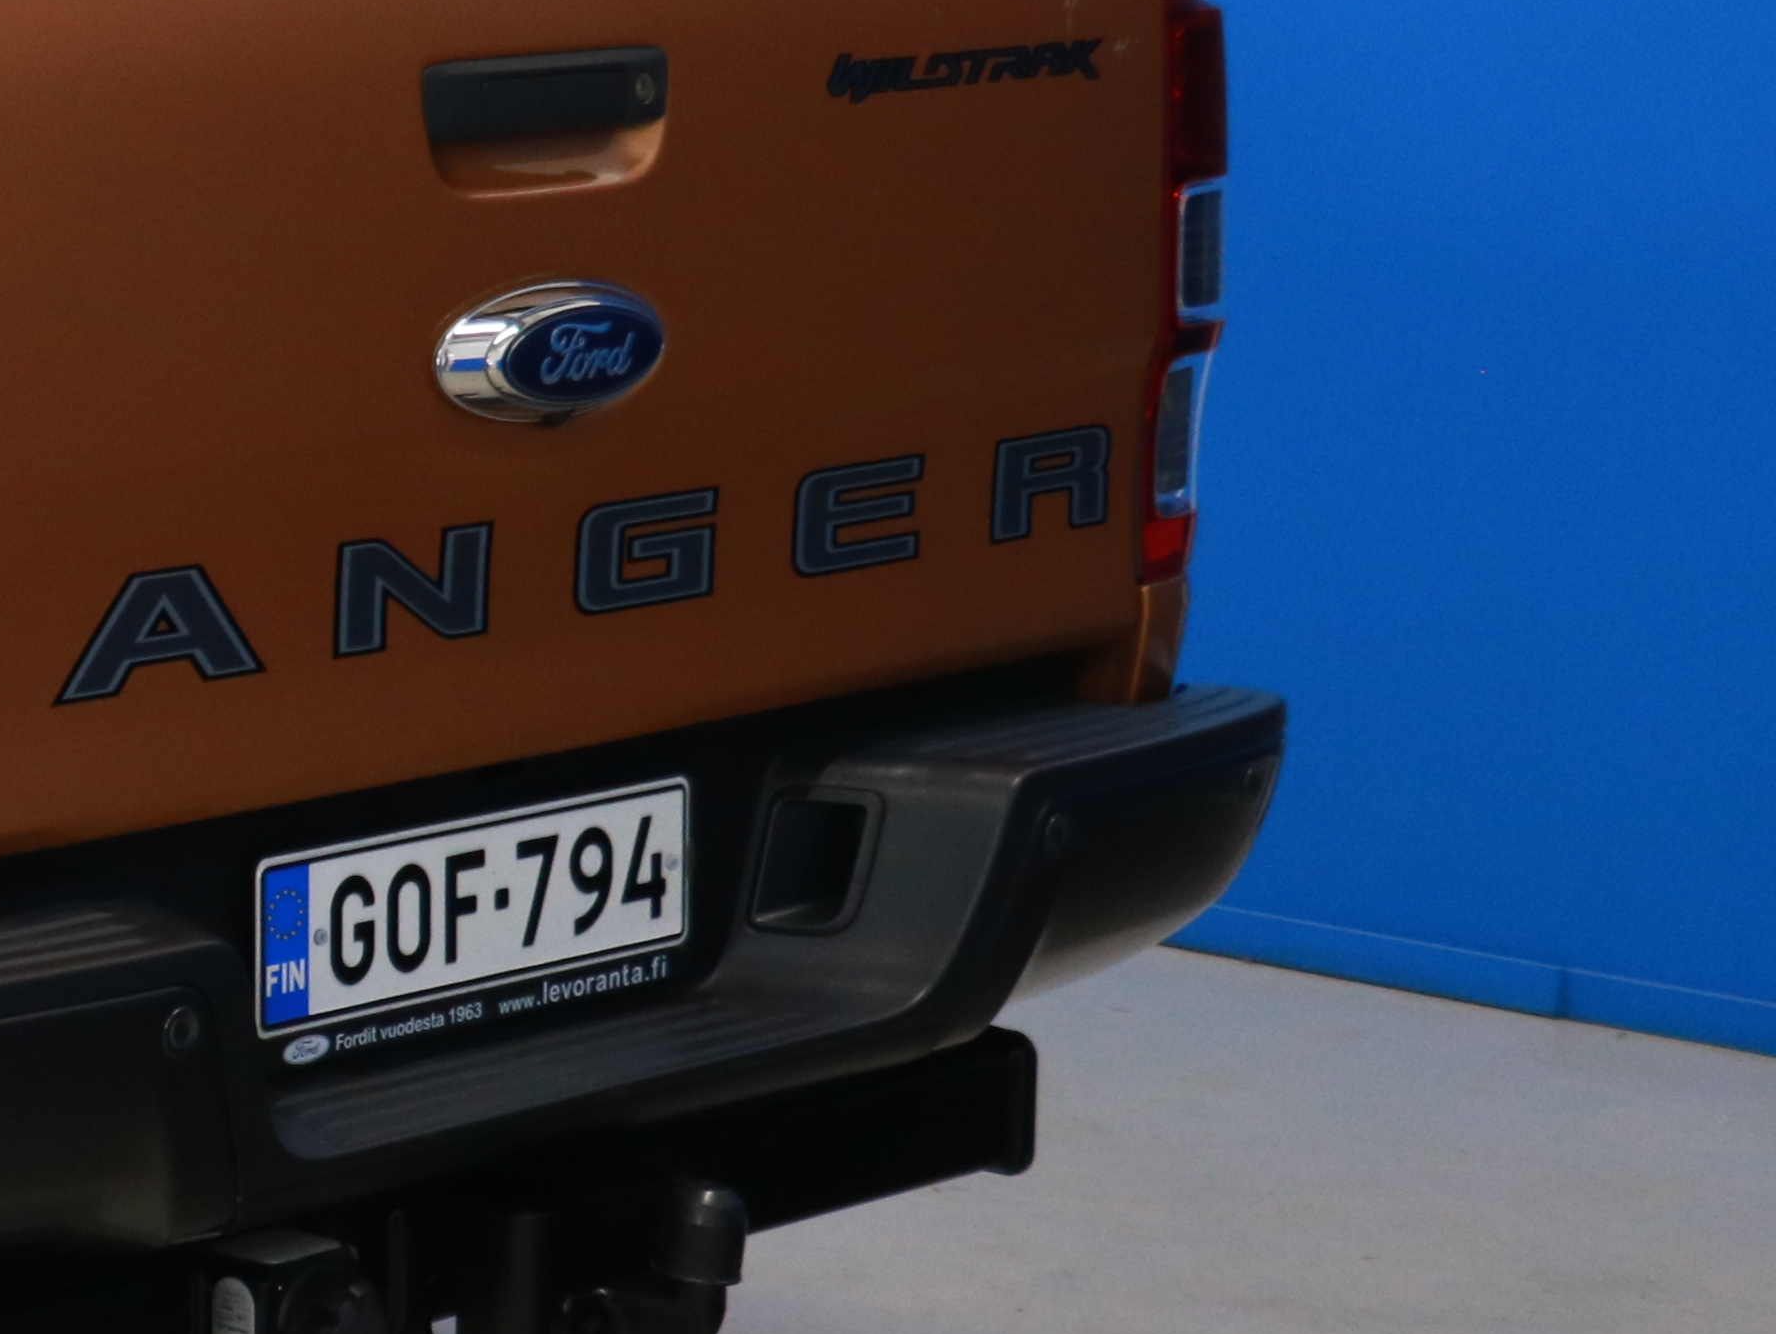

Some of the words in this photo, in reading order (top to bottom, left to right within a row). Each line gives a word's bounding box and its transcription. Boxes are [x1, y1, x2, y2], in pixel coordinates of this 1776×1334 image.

[826, 37, 1105, 104] WILDTRAK
[539, 320, 636, 386] Ford
[328, 814, 667, 987] GOF-794
[265, 958, 306, 999] FIN
[335, 1025, 378, 1051] Fordit
[379, 1014, 446, 1041] vuodesta
[447, 1001, 484, 1026] 1963
[498, 955, 669, 1015] www.levoranta.fi
